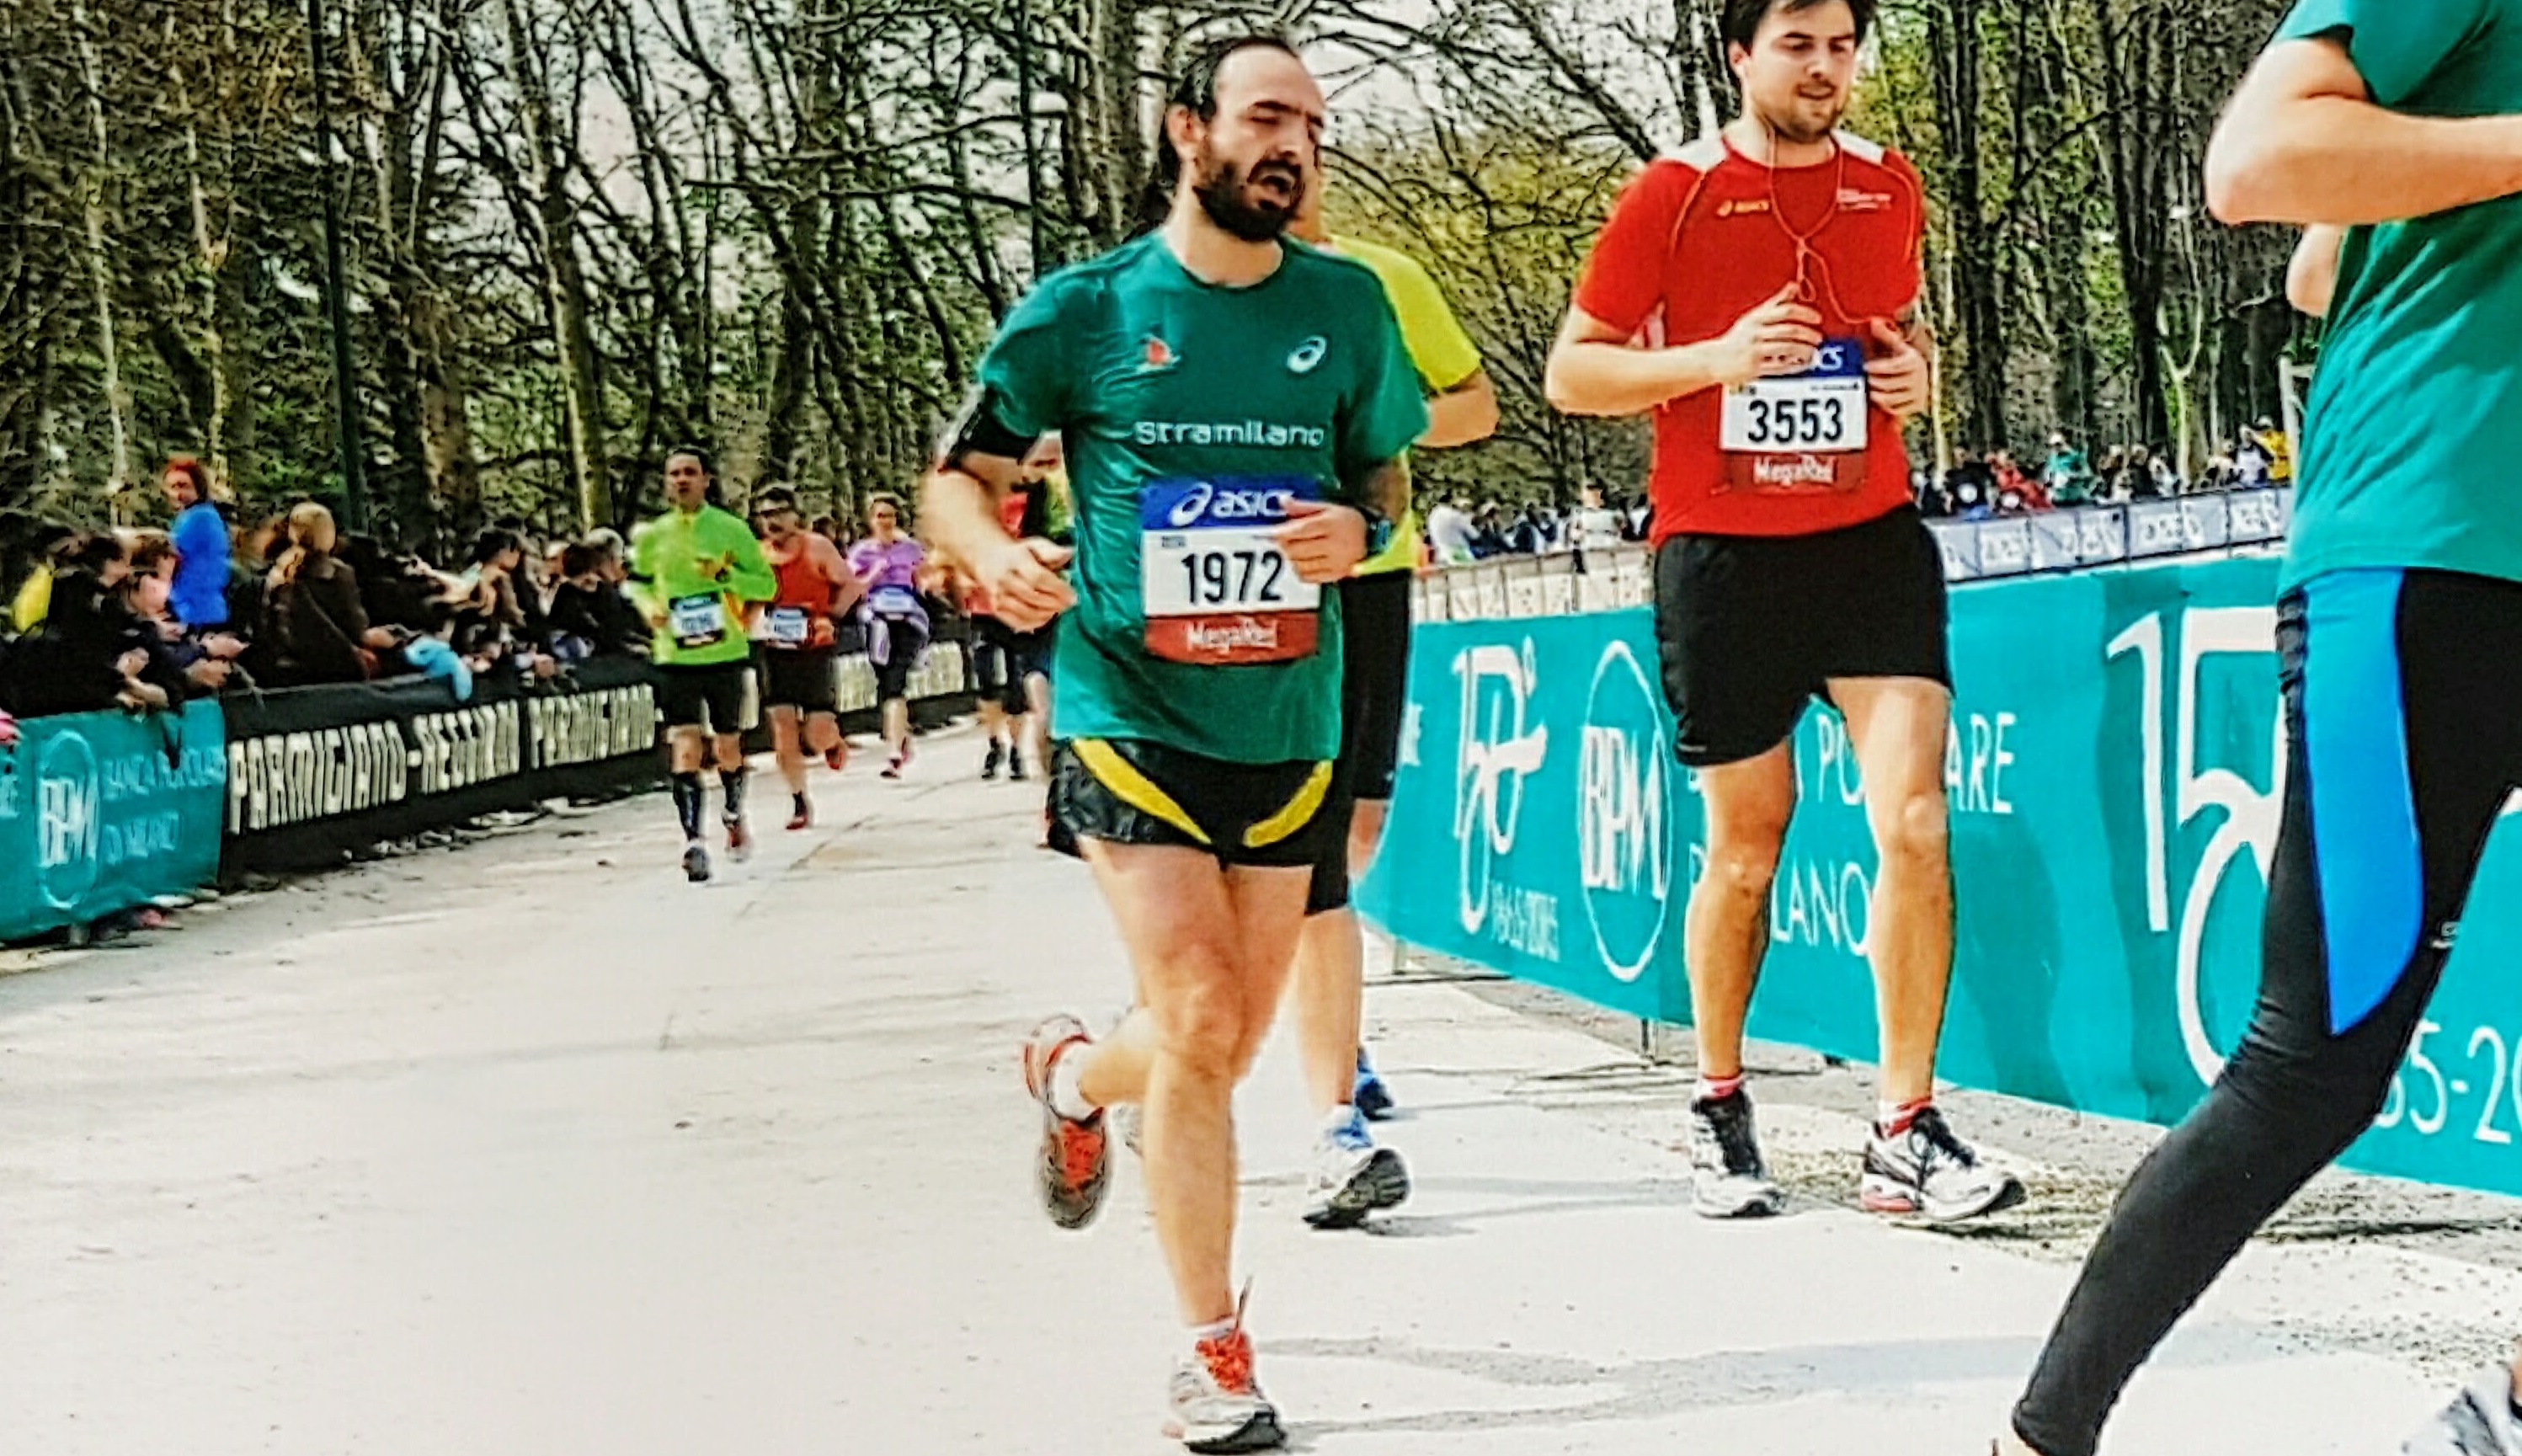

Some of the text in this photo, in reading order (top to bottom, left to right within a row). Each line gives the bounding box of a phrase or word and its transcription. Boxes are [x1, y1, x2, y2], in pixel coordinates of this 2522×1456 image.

[1747, 397, 1843, 443] 3553
[1181, 551, 1283, 604] 1972
[1580, 726, 1667, 901] BPM
